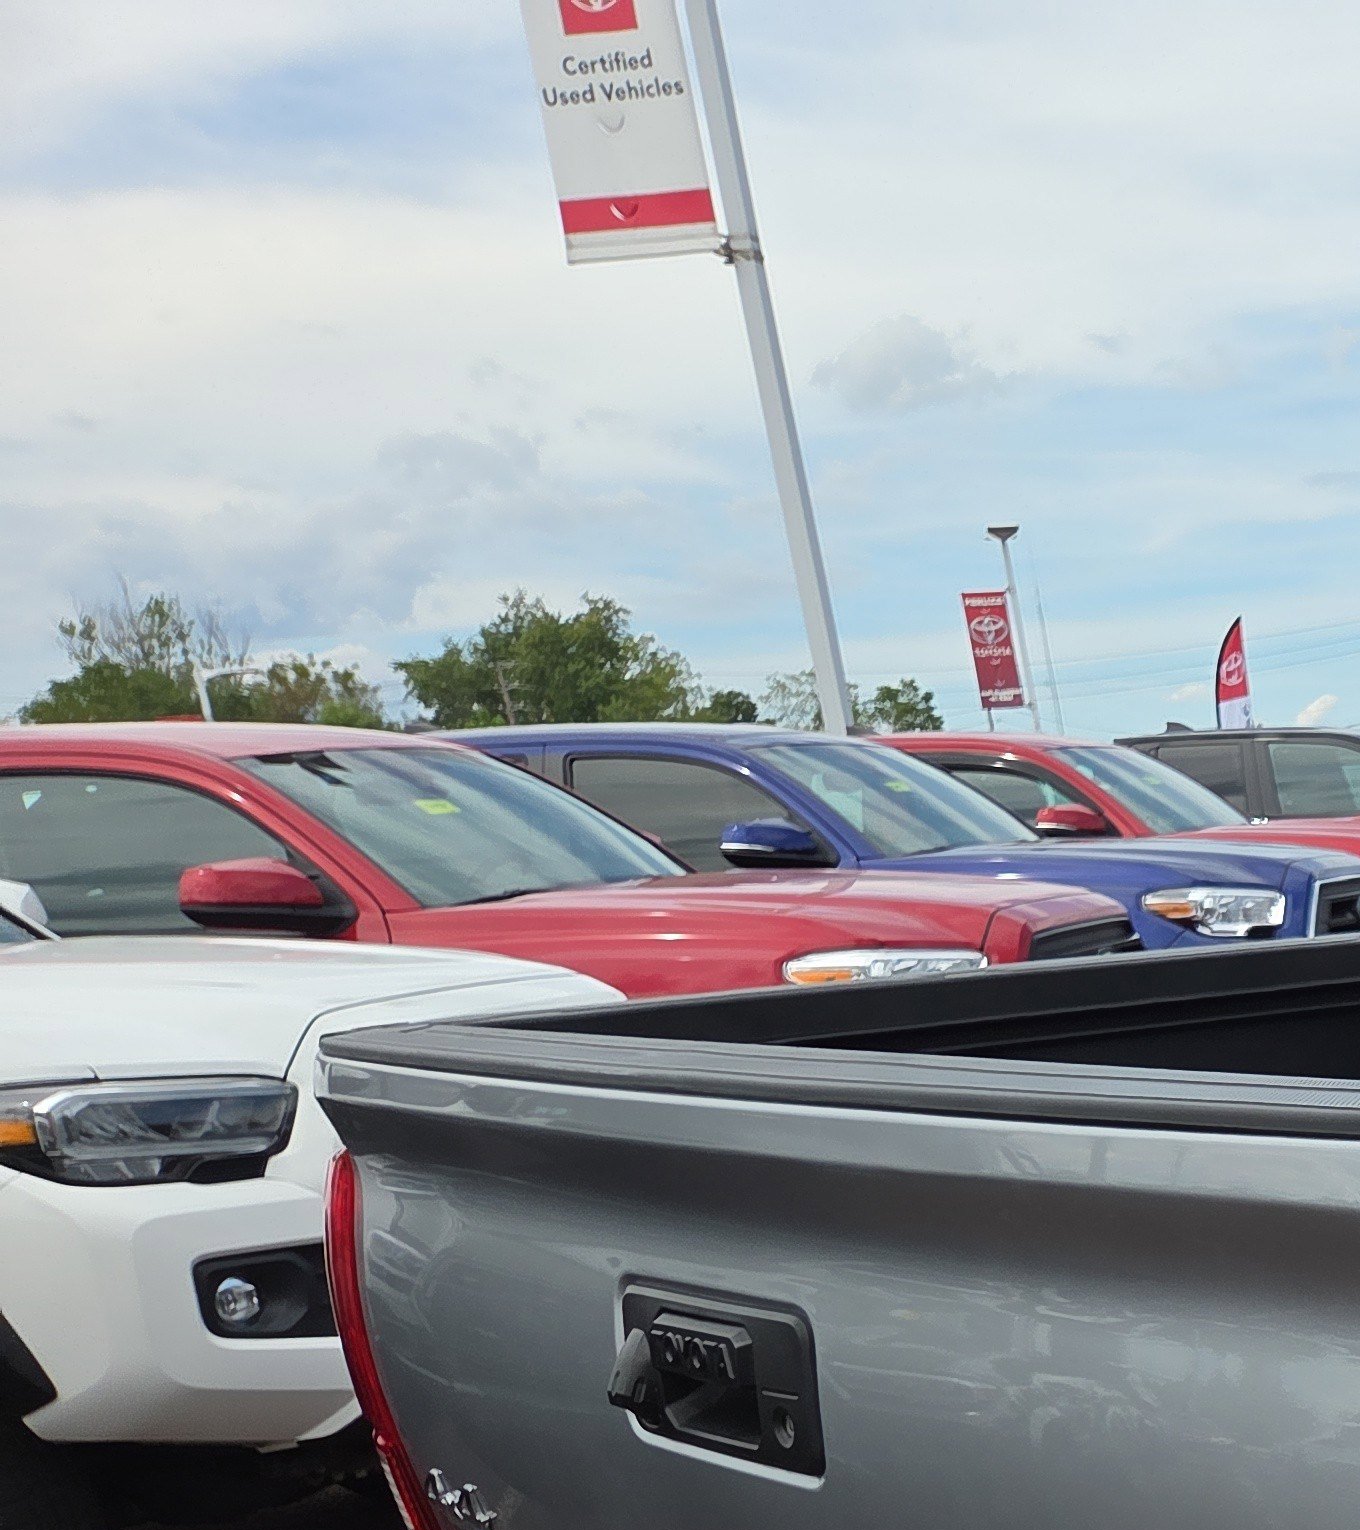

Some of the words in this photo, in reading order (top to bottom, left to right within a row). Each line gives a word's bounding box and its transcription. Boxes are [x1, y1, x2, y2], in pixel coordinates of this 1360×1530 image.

[562, 47, 653, 76] Certified
[541, 83, 595, 107] Used
[601, 77, 684, 103] Vehicles
